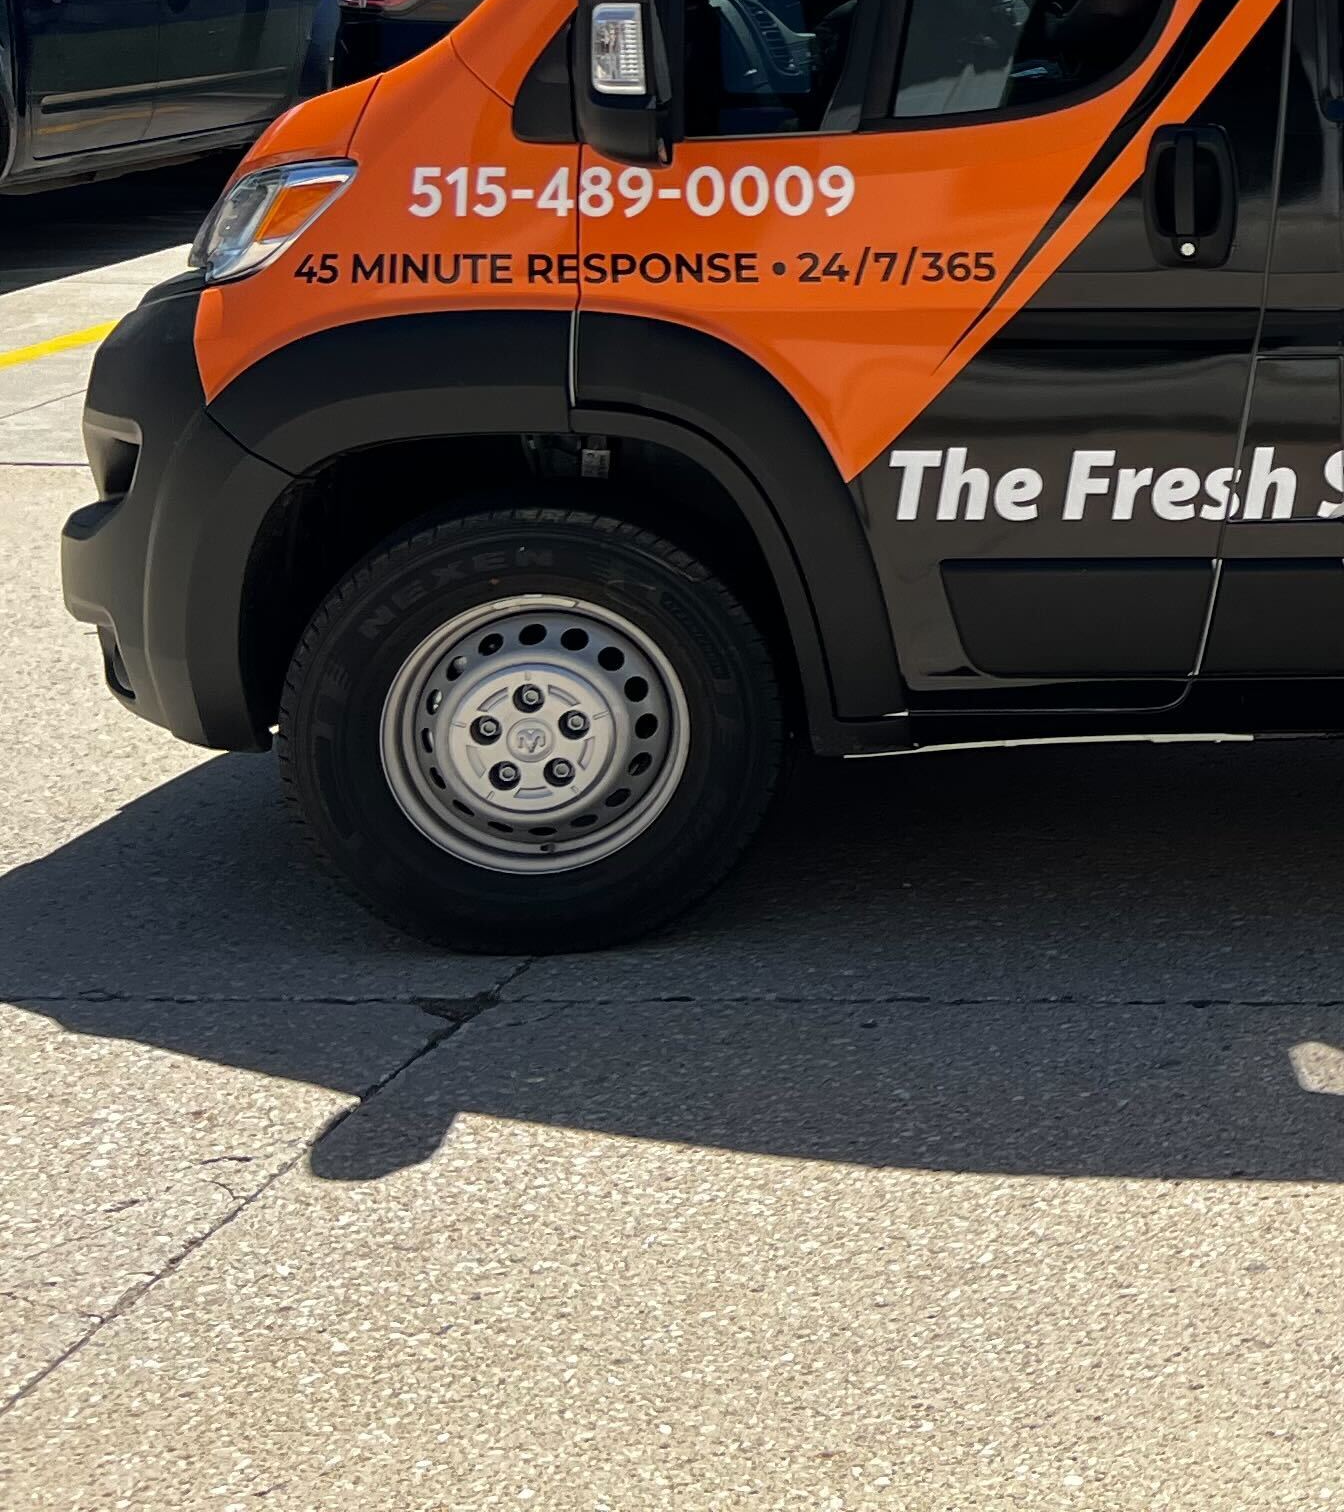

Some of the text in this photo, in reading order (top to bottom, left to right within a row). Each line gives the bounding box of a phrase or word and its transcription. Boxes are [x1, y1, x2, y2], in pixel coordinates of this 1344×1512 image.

[408, 165, 855, 217] 515-489-0009
[293, 247, 997, 286] 45 MINUTE RESPONSE 24/7/365
[889, 446, 1040, 522] The
[1062, 446, 1297, 522] Fresh
[358, 549, 555, 640] NEXEN
